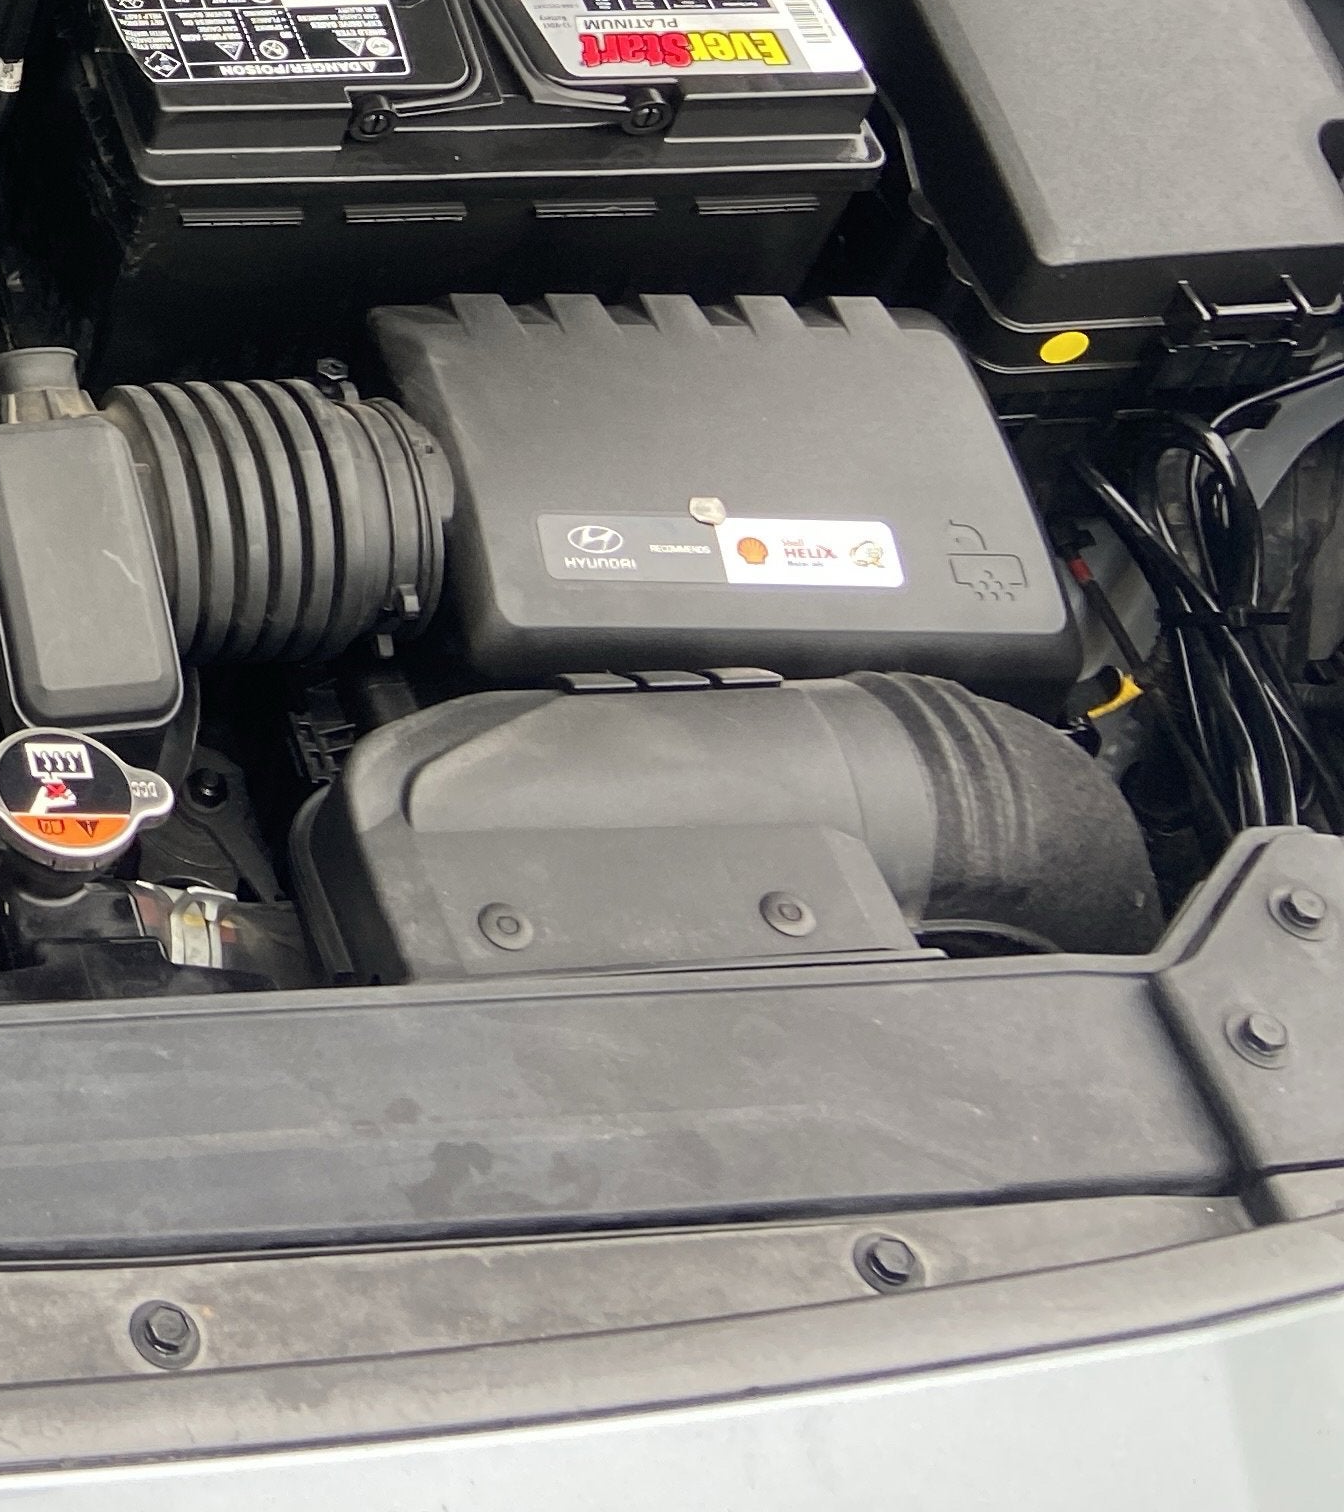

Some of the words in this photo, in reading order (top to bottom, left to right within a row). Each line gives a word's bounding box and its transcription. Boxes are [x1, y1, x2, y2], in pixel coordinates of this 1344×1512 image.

[583, 18, 679, 31] PLATINUM
[578, 31, 791, 69] EverStart
[218, 61, 363, 77] DANGER/POISON
[563, 557, 638, 570] HYUNDAI
[648, 544, 712, 555] RECOMMENDS
[783, 545, 838, 559] HELIX
